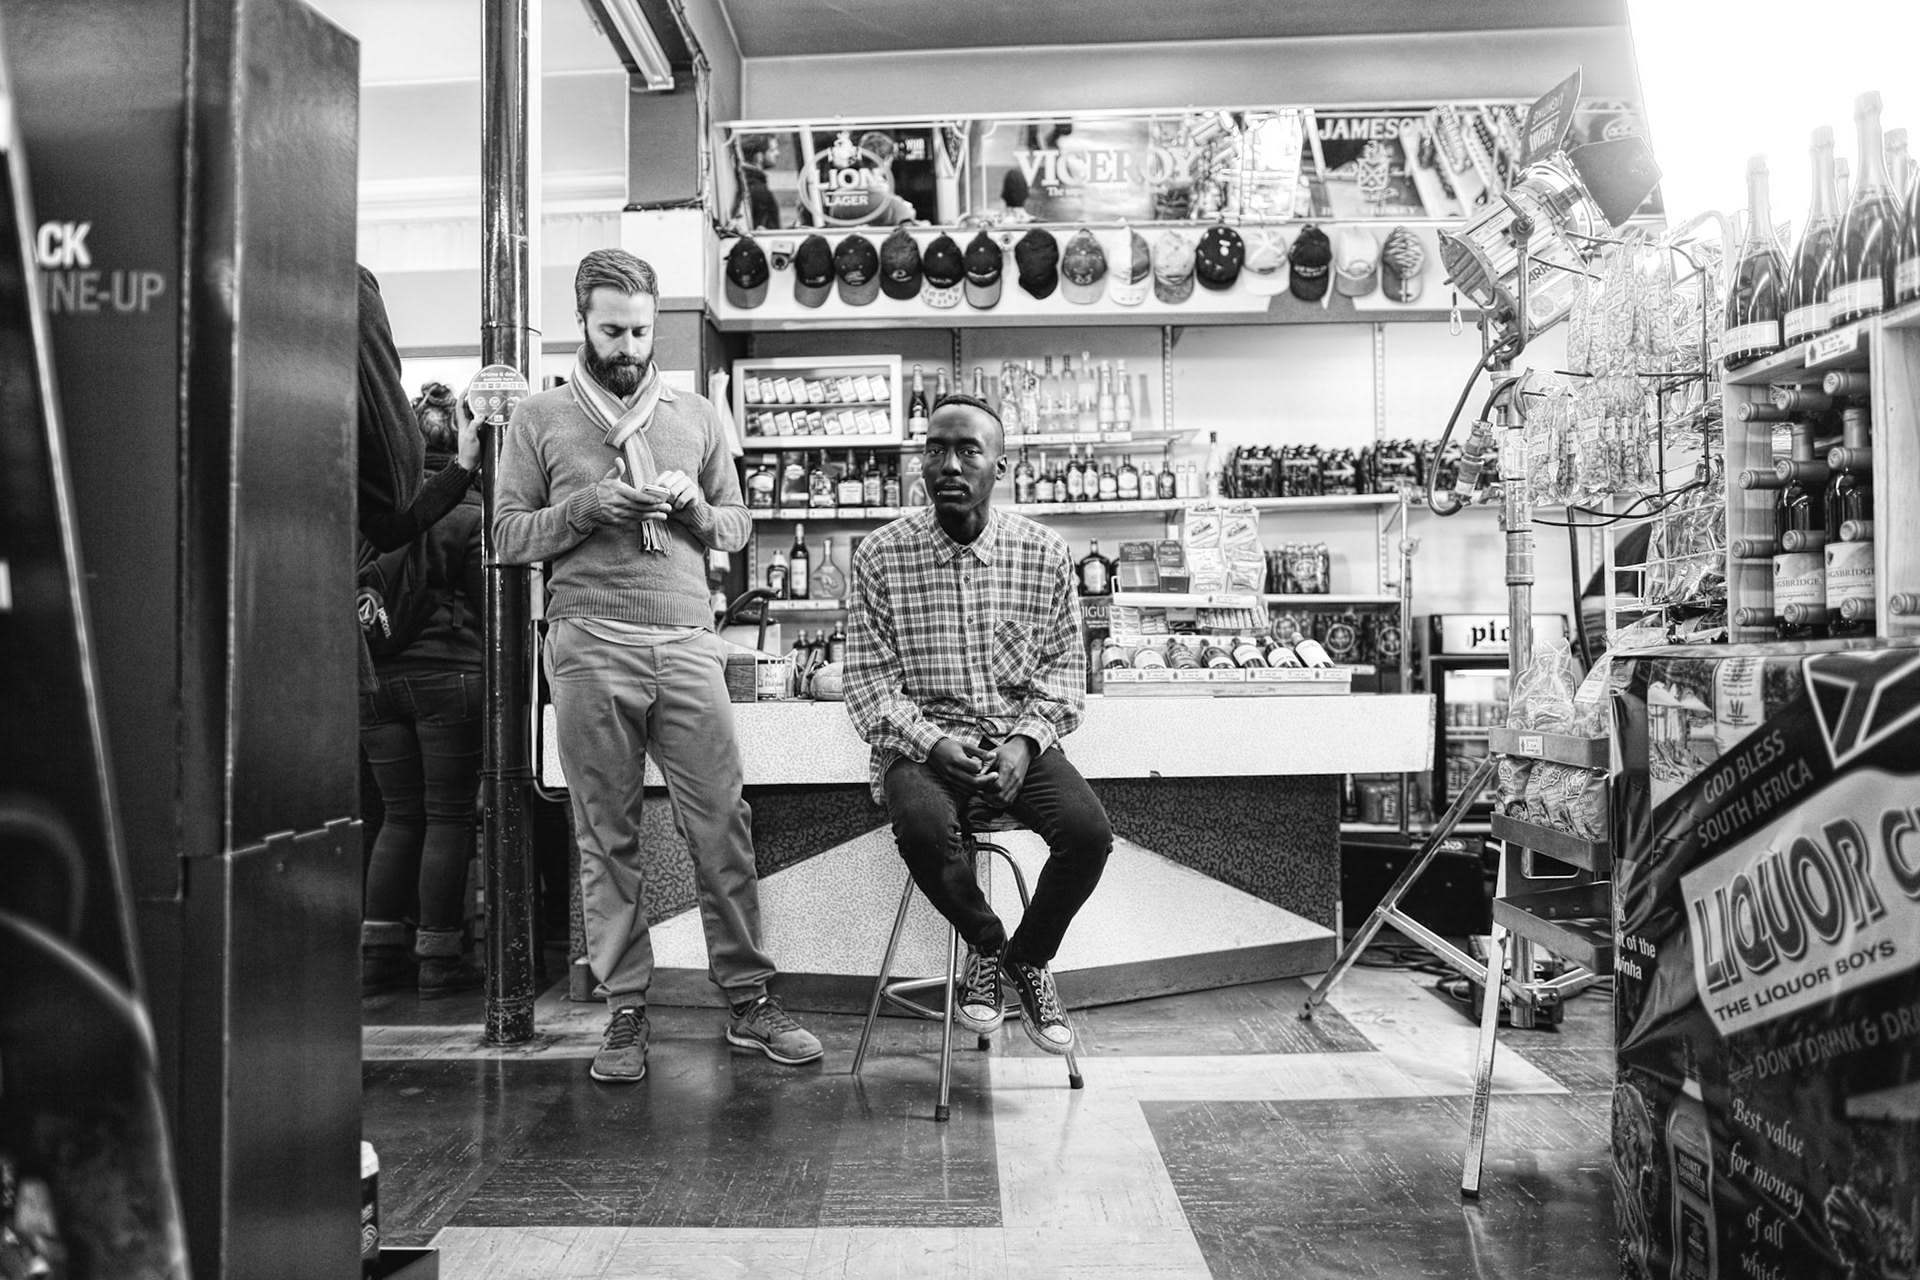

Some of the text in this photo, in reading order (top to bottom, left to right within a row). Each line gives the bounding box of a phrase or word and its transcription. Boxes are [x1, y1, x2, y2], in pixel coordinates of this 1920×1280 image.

[810, 167, 885, 190] LION
[1013, 147, 1203, 187] VICEROY
[825, 195, 869, 206] LAGER
[35, 219, 92, 268] CK
[1528, 259, 1553, 284] ARR
[1703, 730, 1786, 804] GOD BLESS
[1697, 757, 1814, 848] SOUTH AFRICA
[1694, 805, 1920, 995] LIQUOR C
[1626, 934, 1637, 952] of
[1638, 936, 1656, 959] the
[1714, 940, 1897, 1022] THE LIQUOR BOYS
[1755, 1043, 1804, 1080] DON'T
[1806, 1025, 1864, 1064] DRINK
[1861, 1017, 1880, 1046] &
[1733, 1098, 1805, 1158] Best value
[1728, 1143, 1805, 1219] for money
[1747, 1206, 1786, 1250] of all
